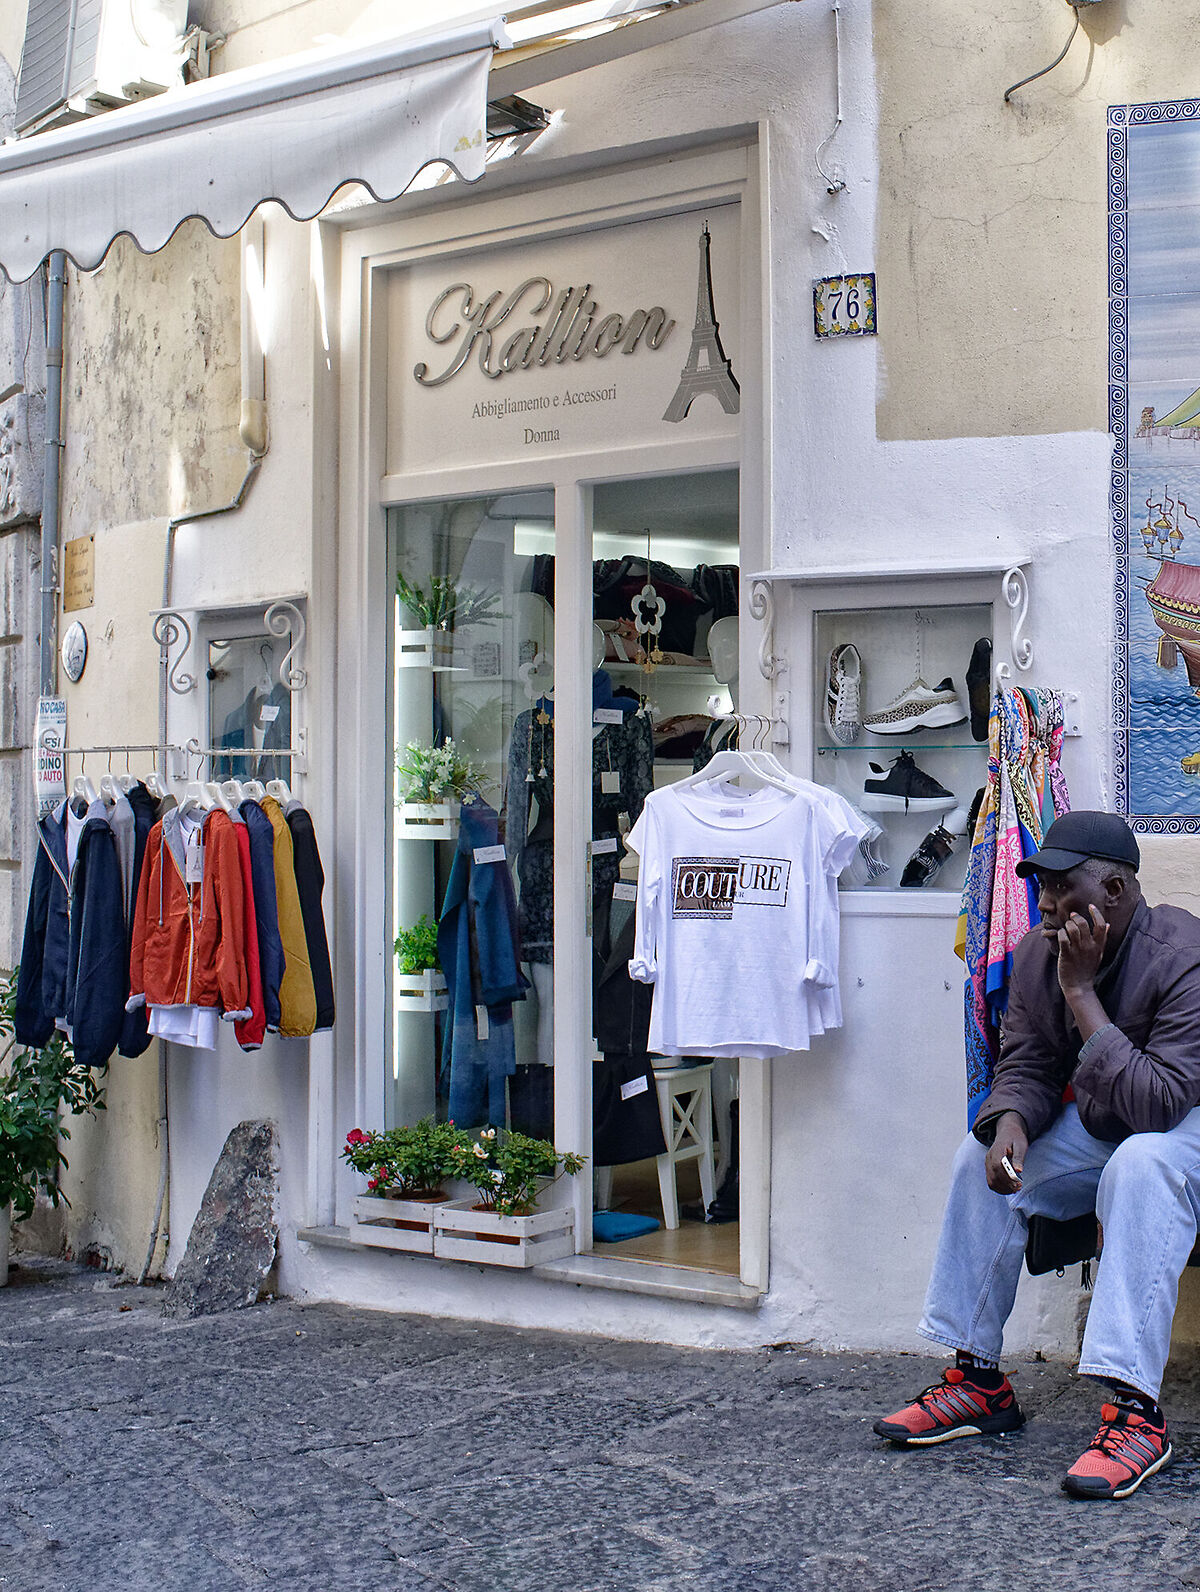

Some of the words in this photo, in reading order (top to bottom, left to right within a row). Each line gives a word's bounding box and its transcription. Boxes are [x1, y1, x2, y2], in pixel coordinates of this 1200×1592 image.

[827, 288, 860, 320] 76
[414, 276, 676, 387] Kallion
[472, 397, 550, 418] Abbigliamento
[553, 396, 560, 407] e
[562, 384, 617, 406] Accessori
[523, 428, 560, 444] Donna
[44, 770, 62, 781] AUTO
[680, 863, 782, 899] COUTURE
